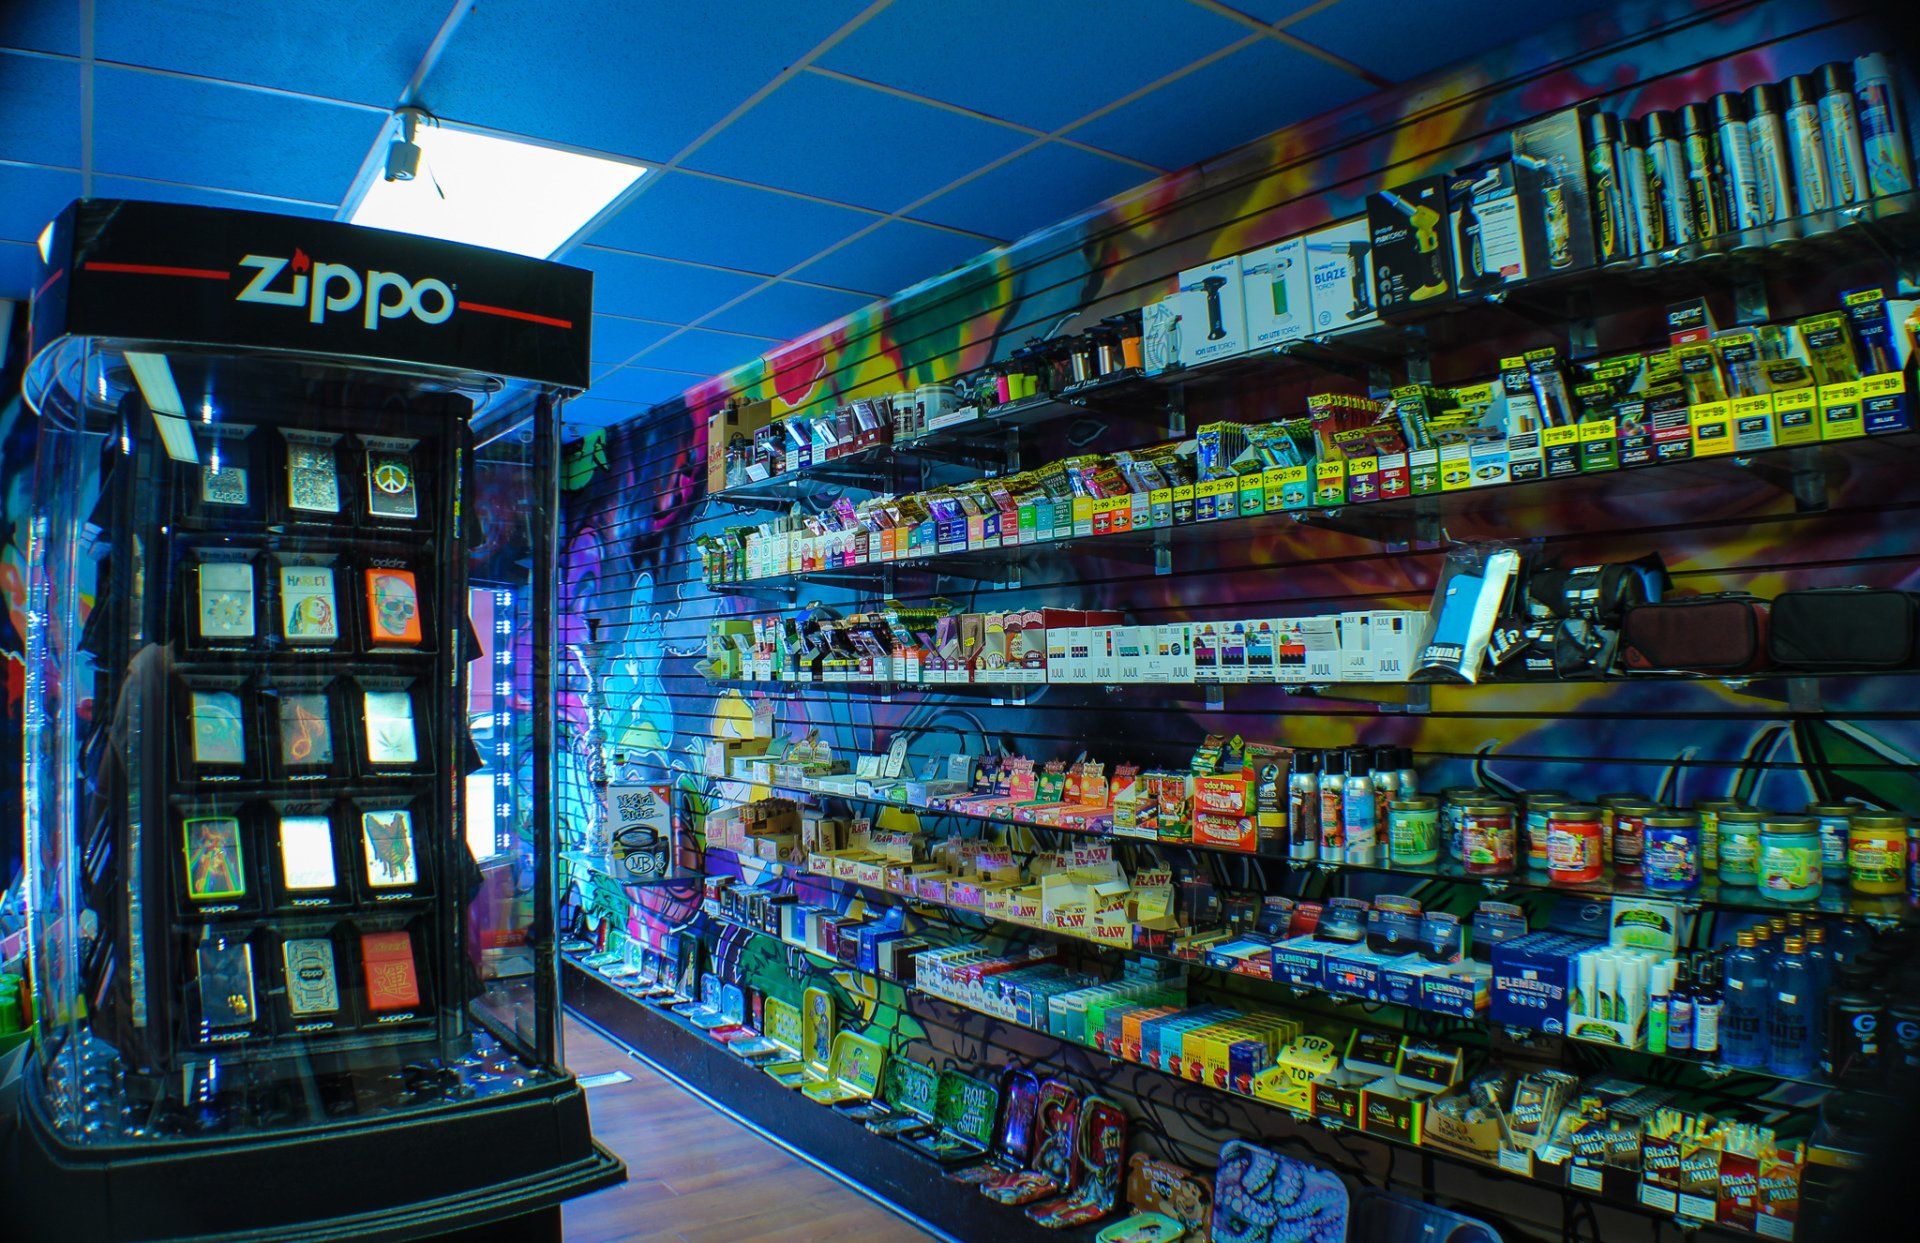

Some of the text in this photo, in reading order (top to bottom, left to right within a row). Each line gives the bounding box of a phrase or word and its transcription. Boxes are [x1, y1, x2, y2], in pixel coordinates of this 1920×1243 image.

[1314, 268, 1347, 285] BLAZE
[235, 248, 455, 330] Zippo
[1668, 306, 1702, 326] Game
[1281, 325, 1300, 336] TORCH
[1860, 326, 1884, 337] BLUE
[1217, 341, 1236, 351] TORCH
[1873, 416, 1896, 424] BLUE
[1657, 441, 1689, 457] Game
[1513, 461, 1539, 476] Game
[1377, 618, 1389, 626] JUUL
[1425, 645, 1462, 658] Skunk
[1310, 663, 1331, 675] JUUL
[1379, 659, 1401, 672] JUUL
[1527, 658, 1553, 668] Skunk
[1051, 668, 1064, 678] JUUL
[1073, 668, 1087, 678] JUUL
[1096, 667, 1111, 677] JUUL
[1123, 667, 1138, 677] JUUL
[1173, 666, 1189, 677] JUUL
[1221, 782, 1235, 791] free
[1206, 816, 1237, 827] odor free
[850, 822, 870, 834] RAW
[984, 852, 1009, 863] RAW
[1074, 848, 1109, 863] RAW
[631, 856, 651, 872] MB
[840, 866, 855, 876] RAW
[861, 872, 879, 881] RAW
[1135, 874, 1170, 886] RAW
[375, 893, 413, 901] Zippo
[923, 888, 942, 897] RAW
[955, 892, 980, 905] RAW
[293, 898, 331, 906] Zippo
[989, 901, 1005, 910] RAW
[199, 905, 239, 913] Zippo
[1013, 905, 1037, 917] RAW
[1056, 914, 1086, 927] RAW
[1623, 909, 1663, 924] 420
[1096, 926, 1126, 938] RAW
[1137, 934, 1166, 946] RAW
[1275, 952, 1319, 969] ELEMENTS
[1328, 961, 1376, 982] ELEMENTS
[1425, 981, 1474, 1000] ELEMENTS
[1496, 976, 1565, 1001] ELEMENTS
[378, 1012, 414, 1023] Zippo
[295, 1021, 334, 1031] Zippo
[1578, 1023, 1616, 1037] 420
[211, 1031, 250, 1041] Zippo
[1302, 1038, 1328, 1051] TOP
[1291, 1067, 1315, 1081] TOP
[905, 1078, 928, 1103] 420
[963, 1083, 988, 1108] ROLL
[1515, 1103, 1542, 1114] Black
[1520, 1113, 1542, 1123] Mild
[957, 1114, 985, 1136] SHIT
[1572, 1130, 1605, 1146] Black
[1607, 1132, 1637, 1145] Black
[1580, 1142, 1605, 1155] Mild
[1614, 1142, 1637, 1153] Mild
[1644, 1145, 1680, 1158] Black
[1653, 1156, 1680, 1169] Mild
[1681, 1158, 1718, 1172] Black
[1690, 1169, 1719, 1183] Mild
[1720, 1172, 1757, 1186] Black
[1758, 1175, 1797, 1189] Black
[1730, 1184, 1757, 1198] Mild
[1768, 1187, 1798, 1201] Mild
